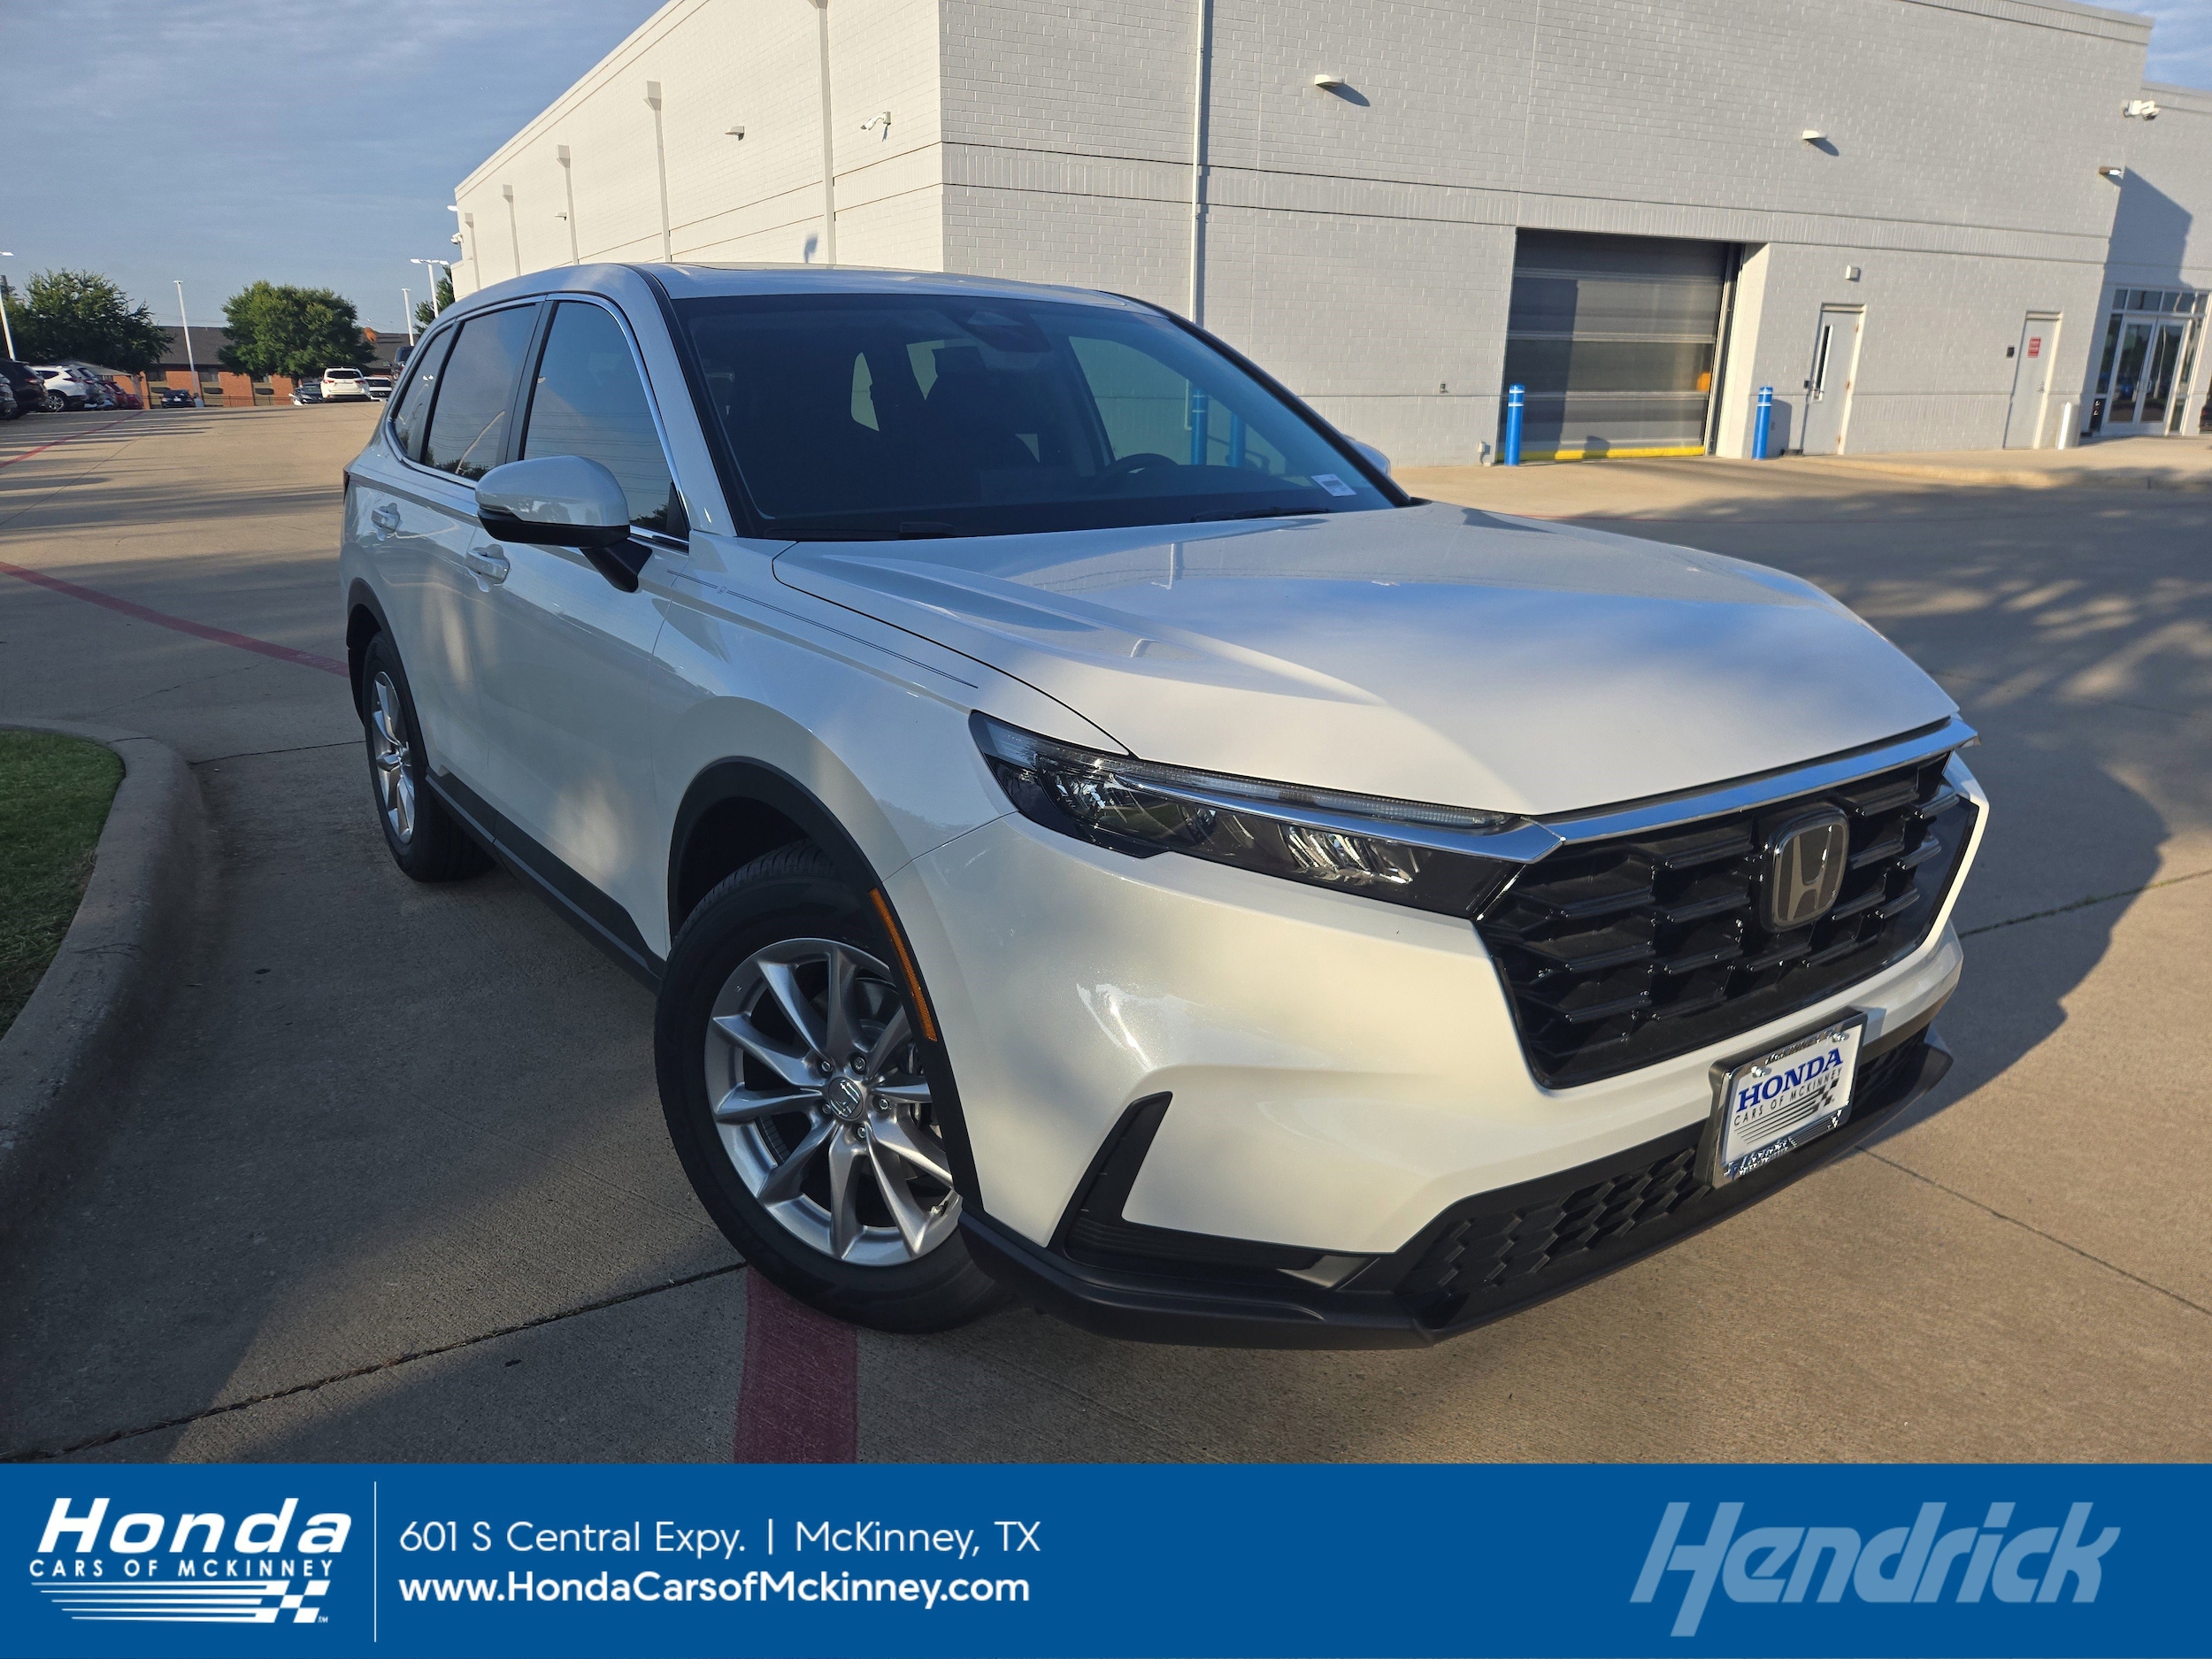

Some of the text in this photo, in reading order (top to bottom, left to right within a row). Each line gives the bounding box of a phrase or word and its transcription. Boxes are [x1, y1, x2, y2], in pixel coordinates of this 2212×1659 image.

[1734, 1067, 1842, 1126] CARS OF MCKINNEY
[1736, 1048, 1843, 1112] HONDA
